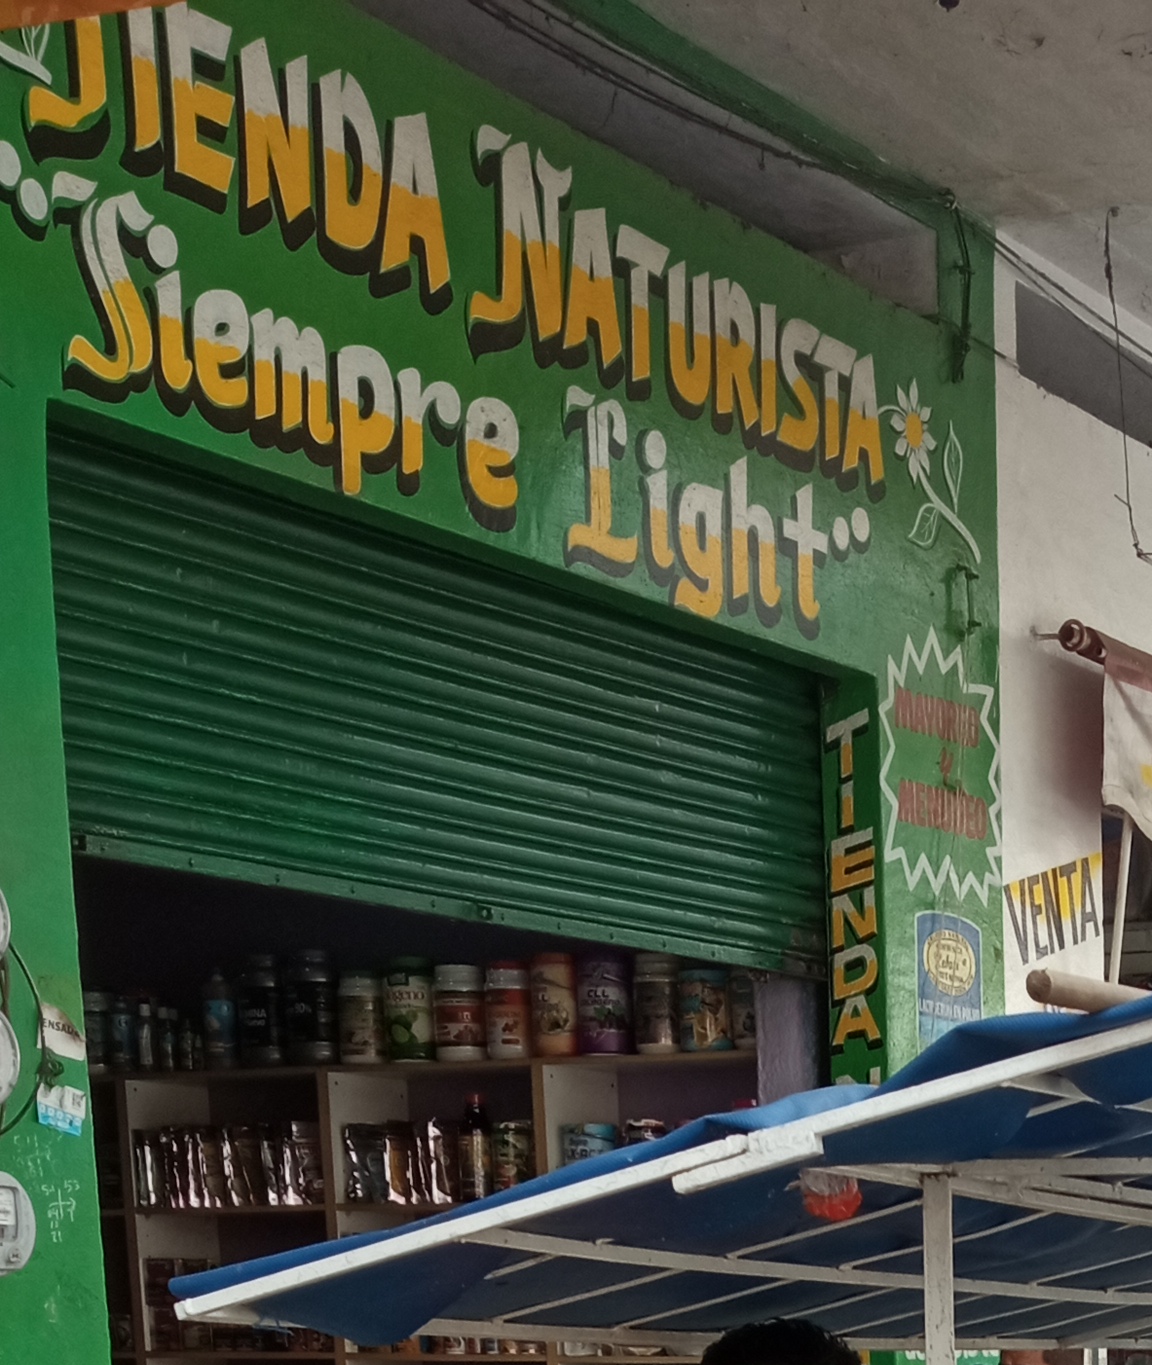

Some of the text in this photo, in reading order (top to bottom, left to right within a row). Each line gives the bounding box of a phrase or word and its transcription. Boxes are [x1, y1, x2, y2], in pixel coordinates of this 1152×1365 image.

[469, 124, 887, 491] NATURISTA
[826, 708, 881, 1045] TIENDA
[1003, 856, 1101, 966] VENTA
